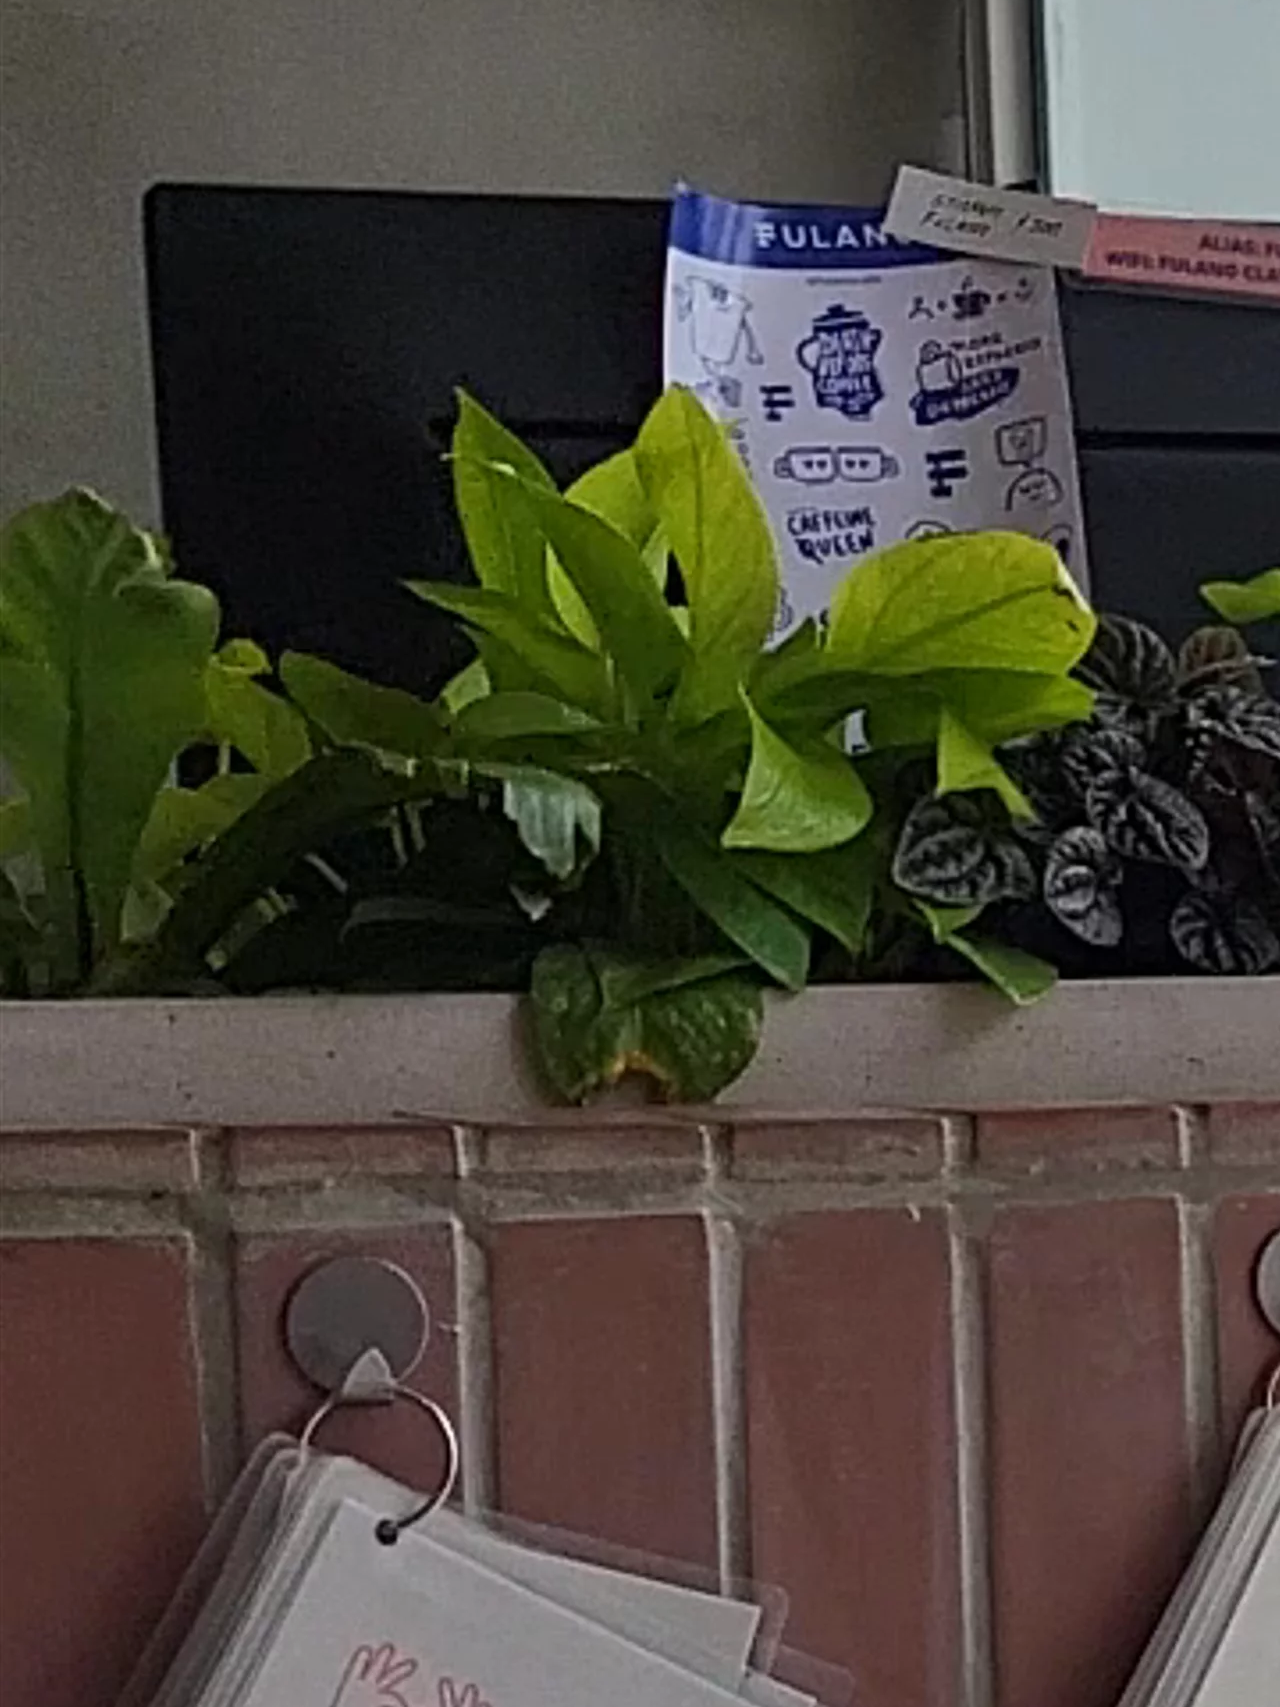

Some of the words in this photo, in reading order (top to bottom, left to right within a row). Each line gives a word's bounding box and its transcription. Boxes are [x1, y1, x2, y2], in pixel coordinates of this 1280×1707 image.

[1200, 233, 1261, 258] ALIAS:
[1158, 255, 1238, 280] FULANO
[786, 507, 878, 537] CAFFEINE
[793, 533, 876, 566] QUEEN
